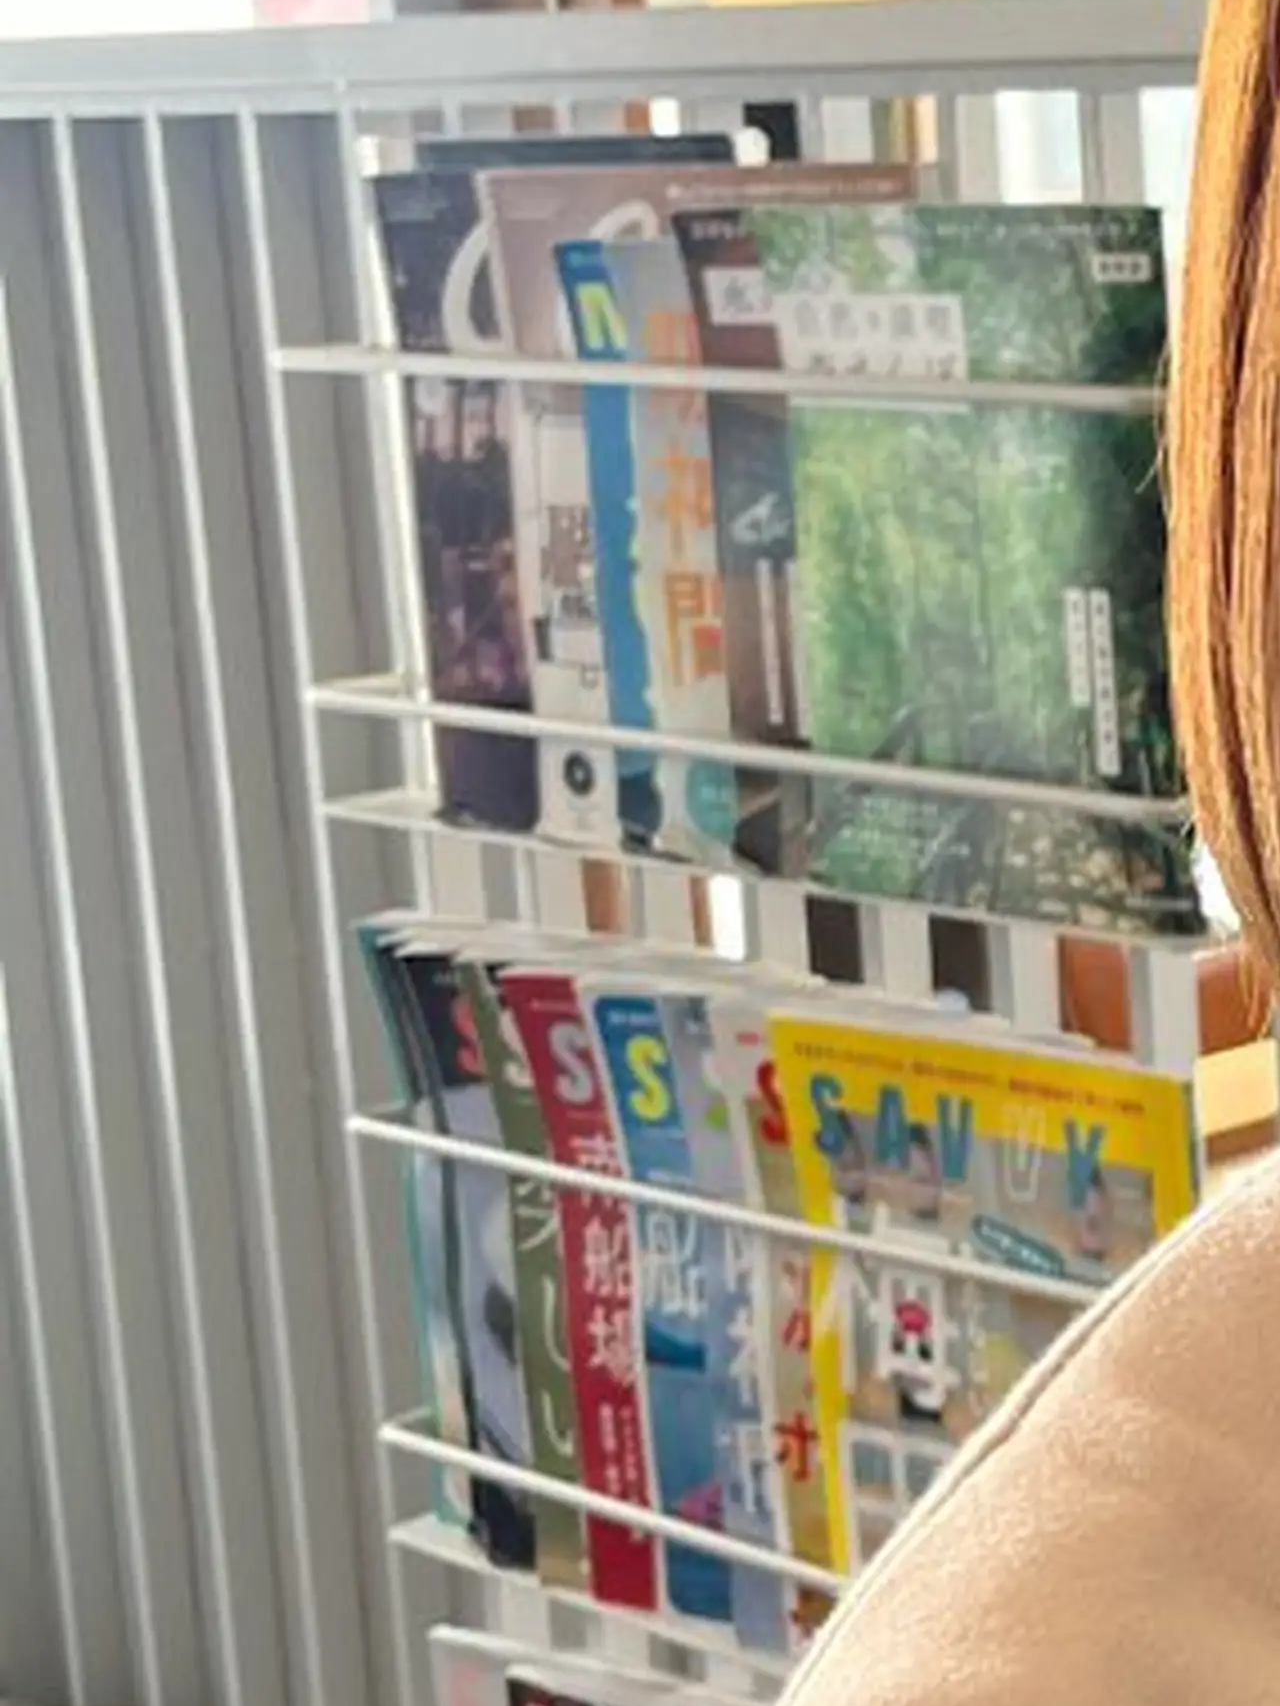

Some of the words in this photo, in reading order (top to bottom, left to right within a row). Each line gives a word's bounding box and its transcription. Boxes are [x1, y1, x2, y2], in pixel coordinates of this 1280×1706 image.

[548, 1020, 594, 1104] S
[626, 1033, 670, 1122] S
[810, 1071, 1106, 1211] SAVVY
